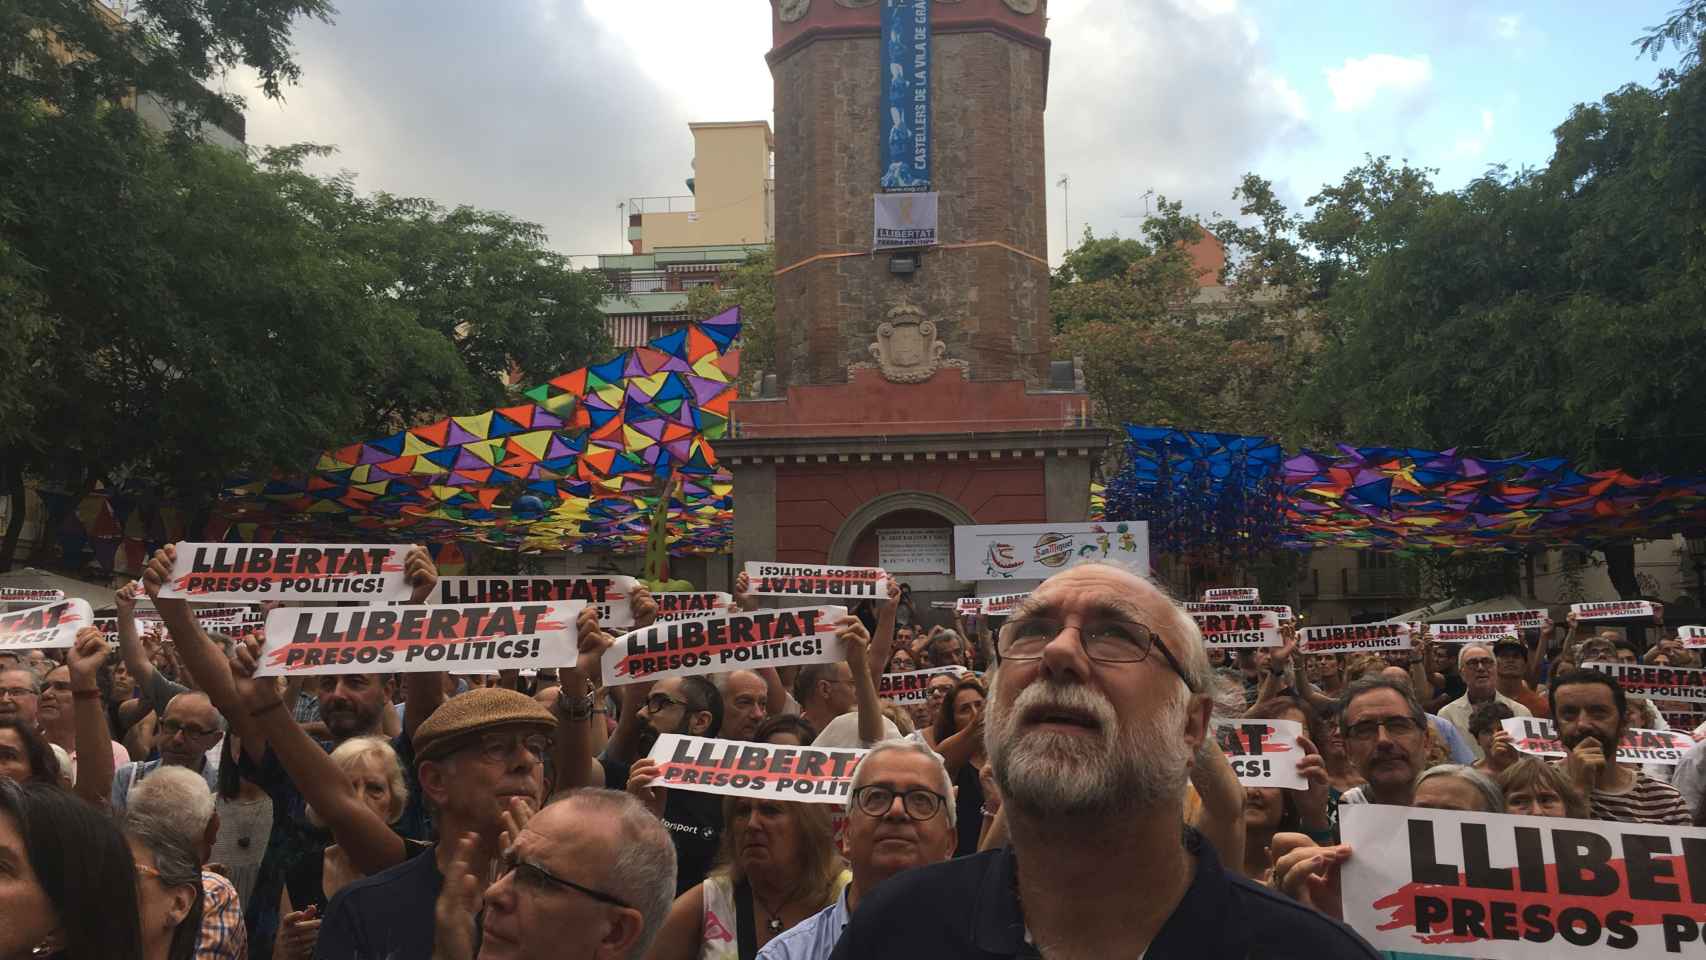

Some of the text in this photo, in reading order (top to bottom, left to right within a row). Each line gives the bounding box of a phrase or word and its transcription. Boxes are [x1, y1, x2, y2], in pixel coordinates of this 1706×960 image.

[914, 26, 927, 40] DE
[914, 42, 927, 68] VILA
[914, 70, 927, 86] LA
[914, 88, 927, 102] DE
[914, 104, 927, 170] CASTELLERS
[191, 547, 390, 575] LLIBERTAT
[187, 574, 385, 594] PRESOS POLÍTICS!
[827, 569, 877, 580] PRESOS
[441, 578, 611, 605] LLIBERTAT
[758, 577, 877, 596] LLIBERTAT
[1580, 602, 1642, 612] LLIBERTAT
[292, 605, 548, 644] LLIBERTAT
[1475, 611, 1540, 624] LLIBERTAT
[627, 610, 820, 656] LLIBERTAT
[1307, 624, 1401, 642] LLIBERTAT
[1439, 625, 1508, 634] LLIBERTAT
[285, 638, 540, 666] PRESOS POLÍTICS!
[1308, 640, 1348, 651] PRESOS
[629, 638, 823, 675] PRESOS POLÍTICS!
[664, 767, 766, 790] PRESOS
[1414, 894, 1639, 951] PRESOS
